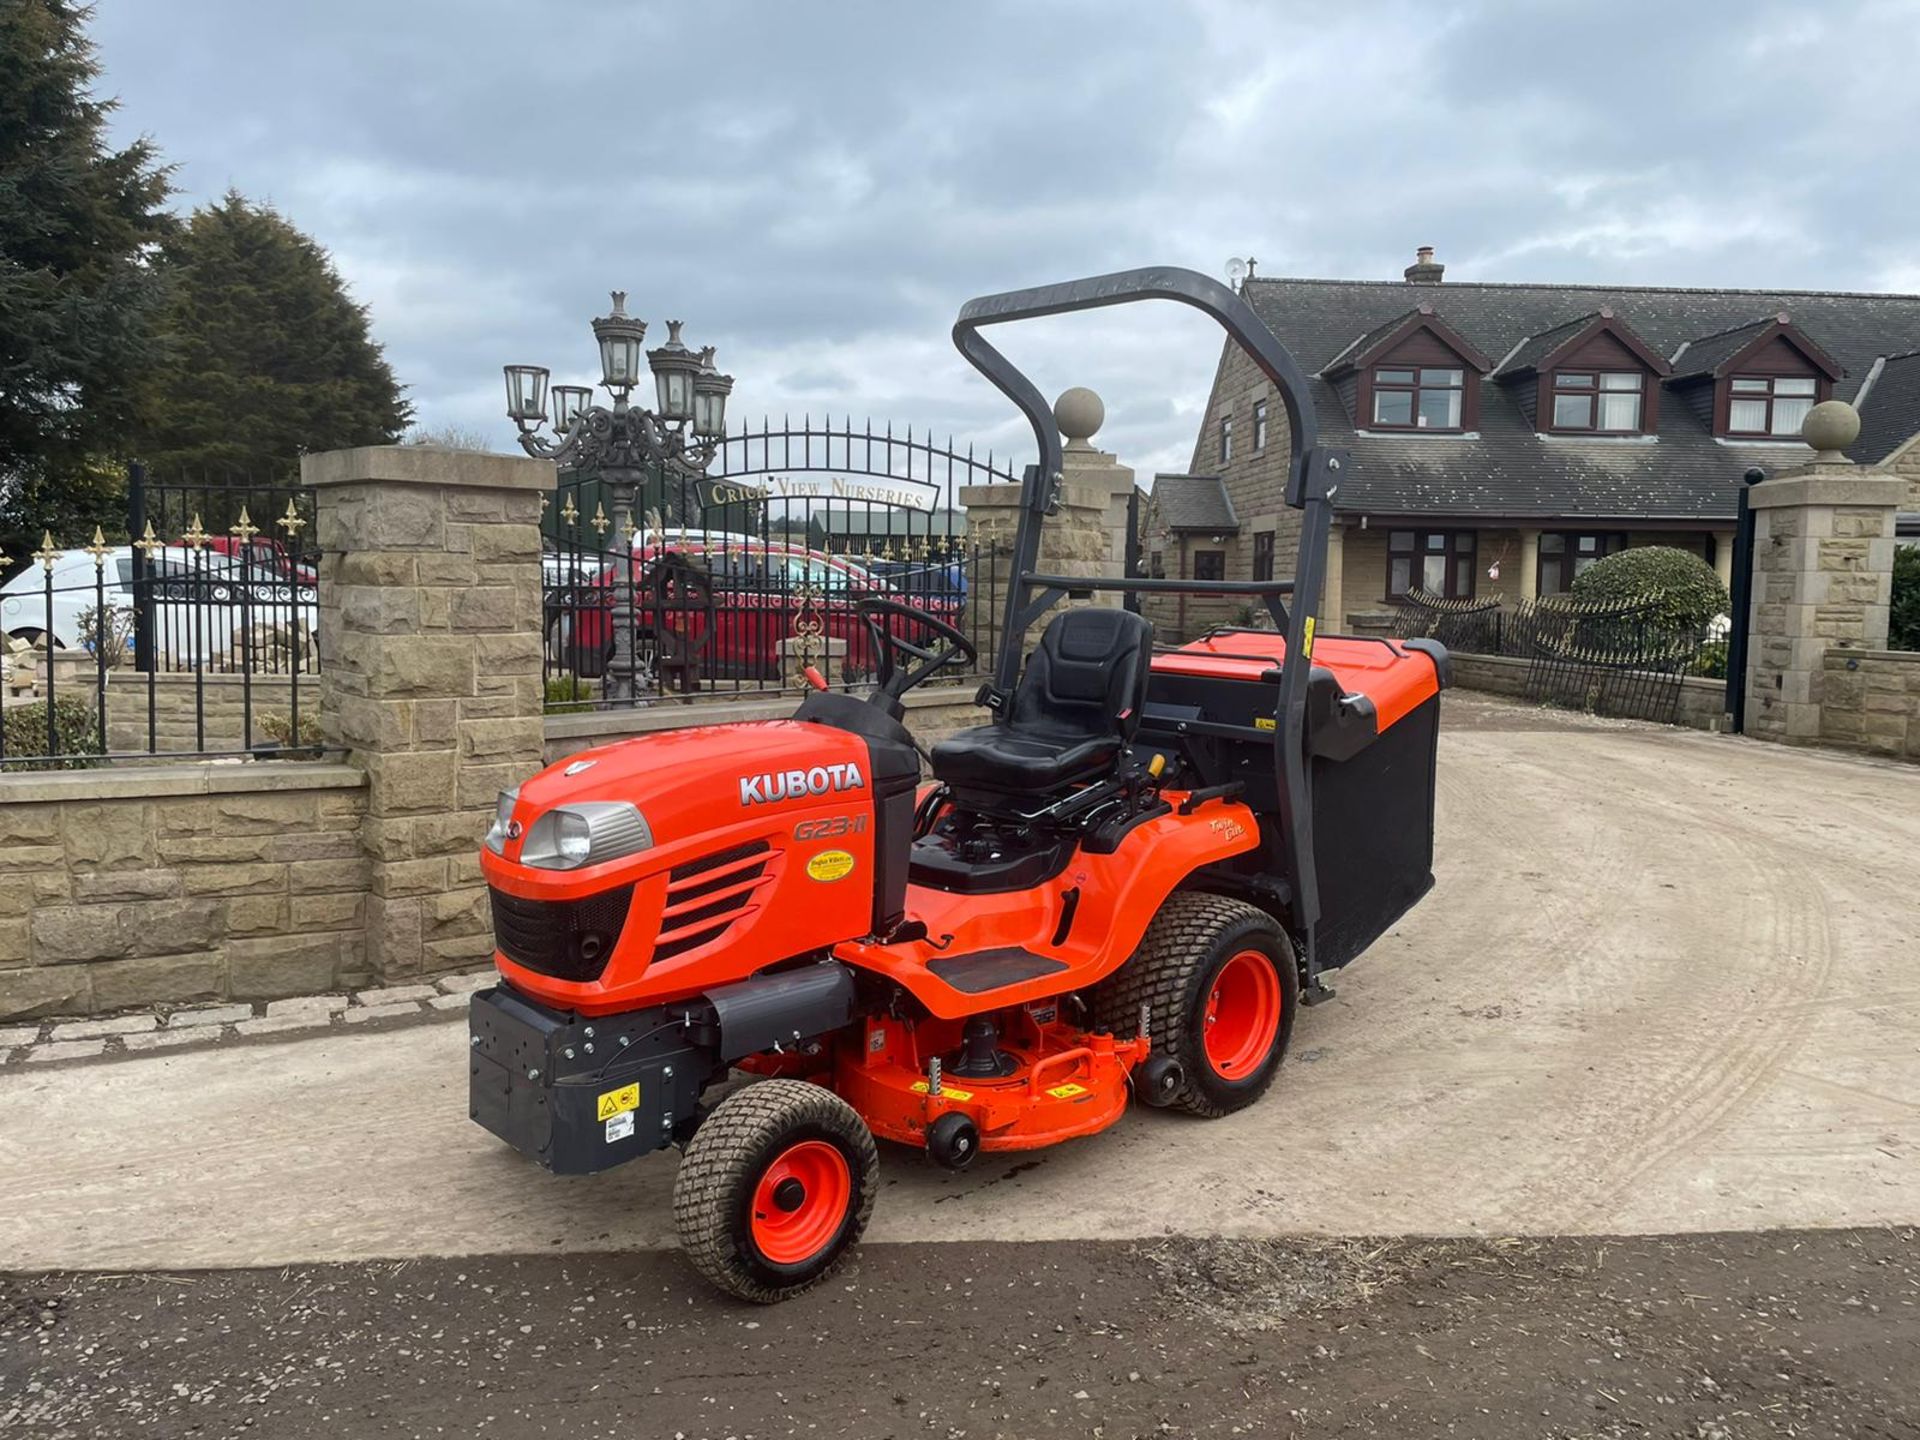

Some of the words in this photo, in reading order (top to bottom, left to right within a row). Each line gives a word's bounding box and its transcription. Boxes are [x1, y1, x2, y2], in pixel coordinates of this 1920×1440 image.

[777, 478, 820, 496] VIEW
[832, 478, 923, 507] NURSERIES
[739, 762, 864, 805] KUBOTA
